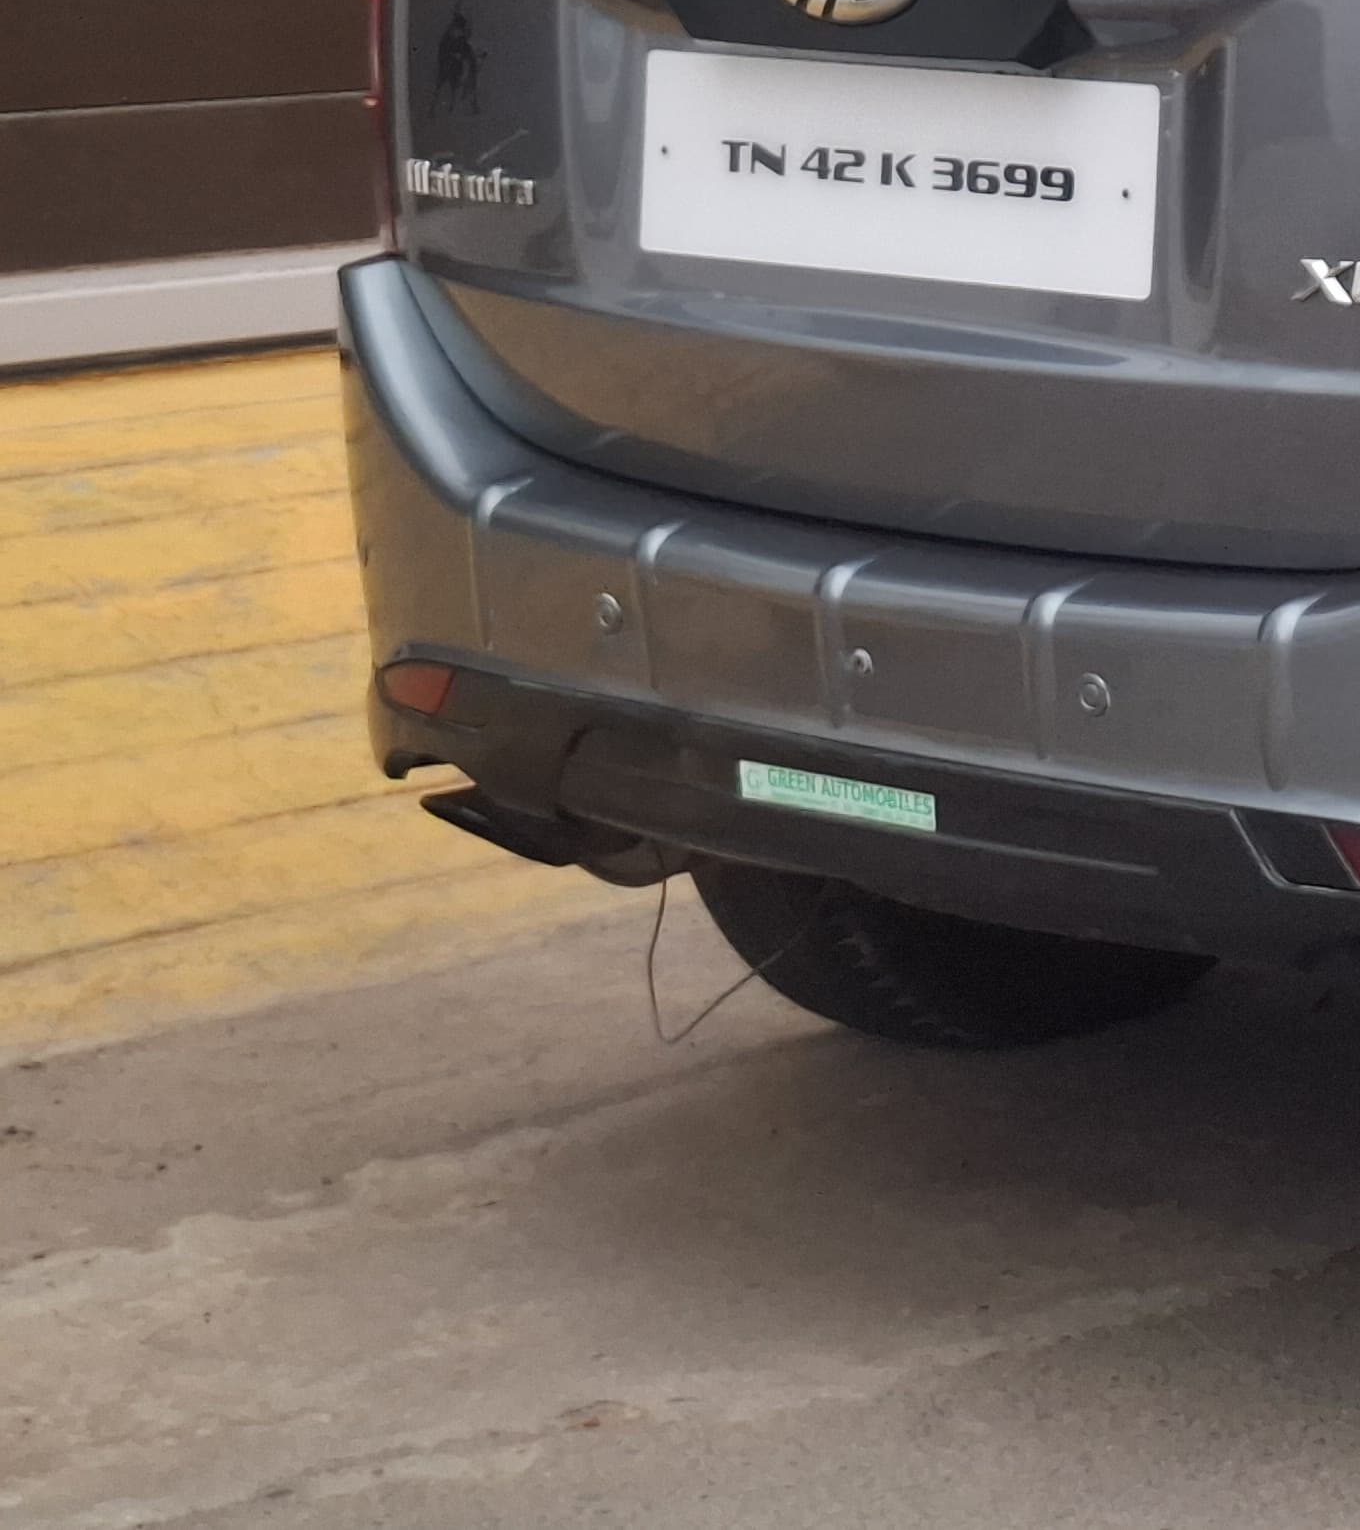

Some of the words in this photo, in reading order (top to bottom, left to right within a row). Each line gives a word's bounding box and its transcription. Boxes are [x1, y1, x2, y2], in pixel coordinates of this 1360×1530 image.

[407, 158, 535, 206] Mahndra
[721, 139, 787, 177] TN
[799, 144, 866, 184] 42
[880, 152, 917, 188] K
[932, 156, 1075, 202] 3699
[767, 768, 816, 794] GREEN
[820, 779, 933, 816] AUTOMOBILES
